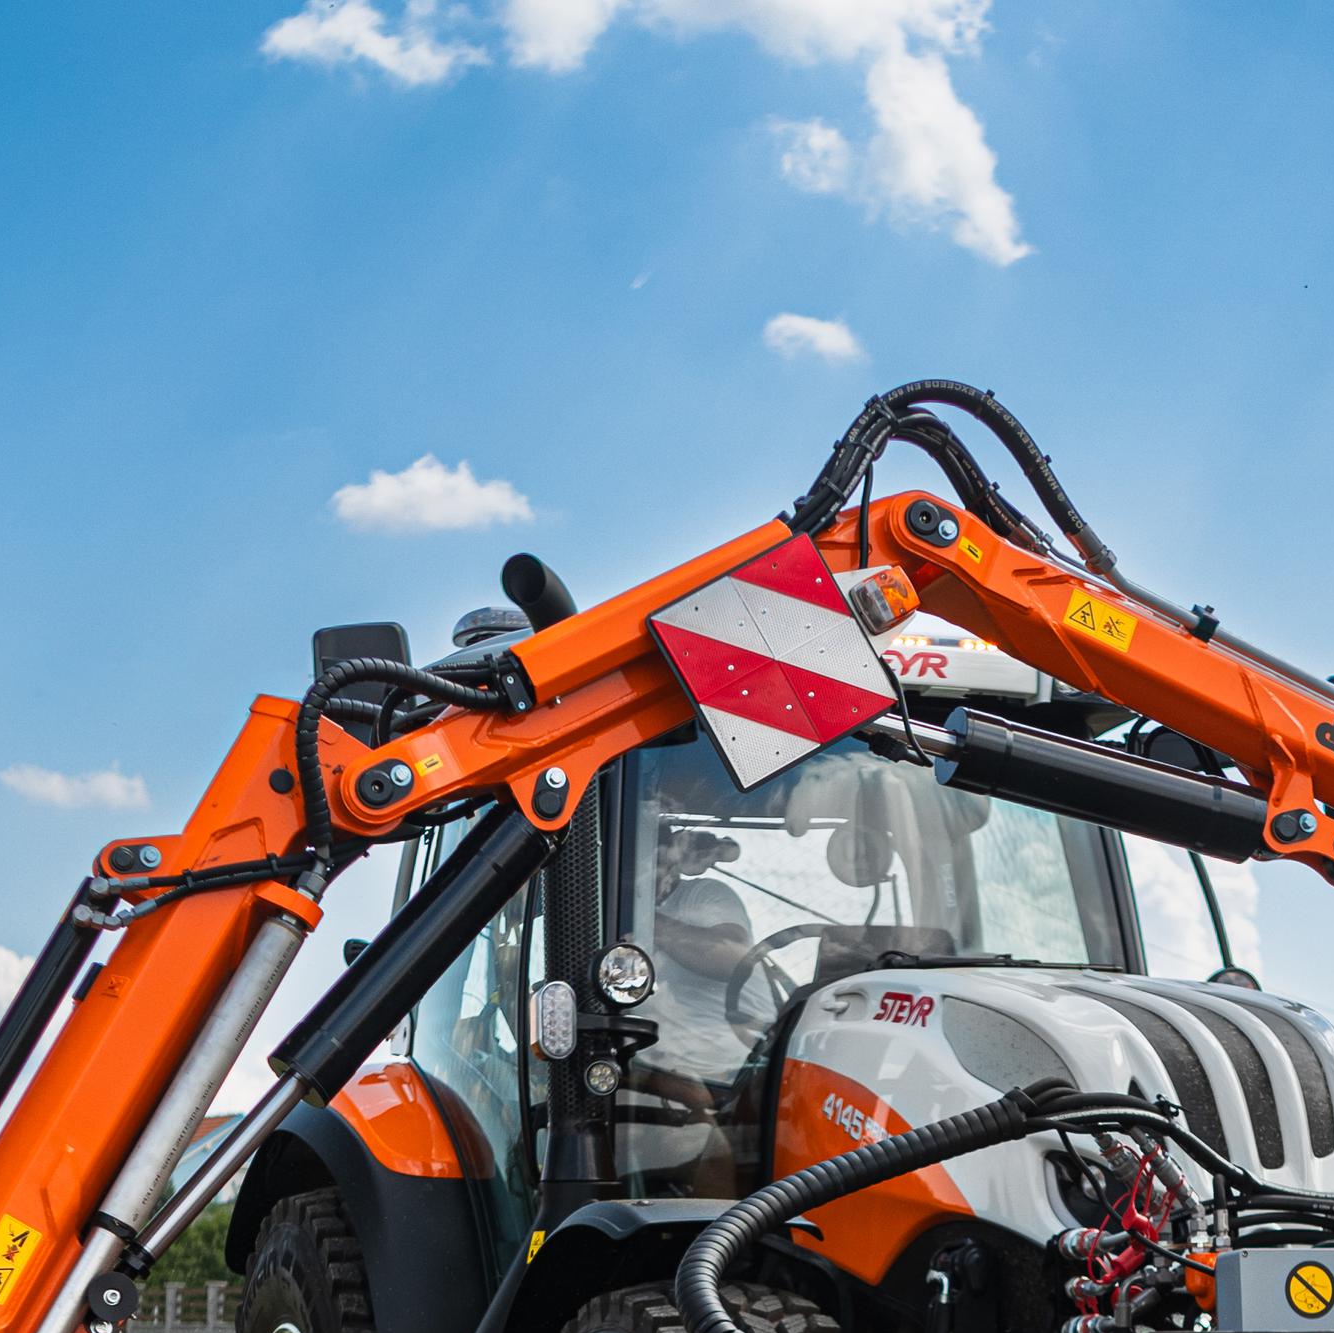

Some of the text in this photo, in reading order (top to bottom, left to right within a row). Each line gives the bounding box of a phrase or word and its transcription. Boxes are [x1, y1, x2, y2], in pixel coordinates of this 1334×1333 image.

[881, 649, 948, 679] EYR
[873, 991, 935, 1028] STEYR
[822, 1093, 865, 1140] 4145
